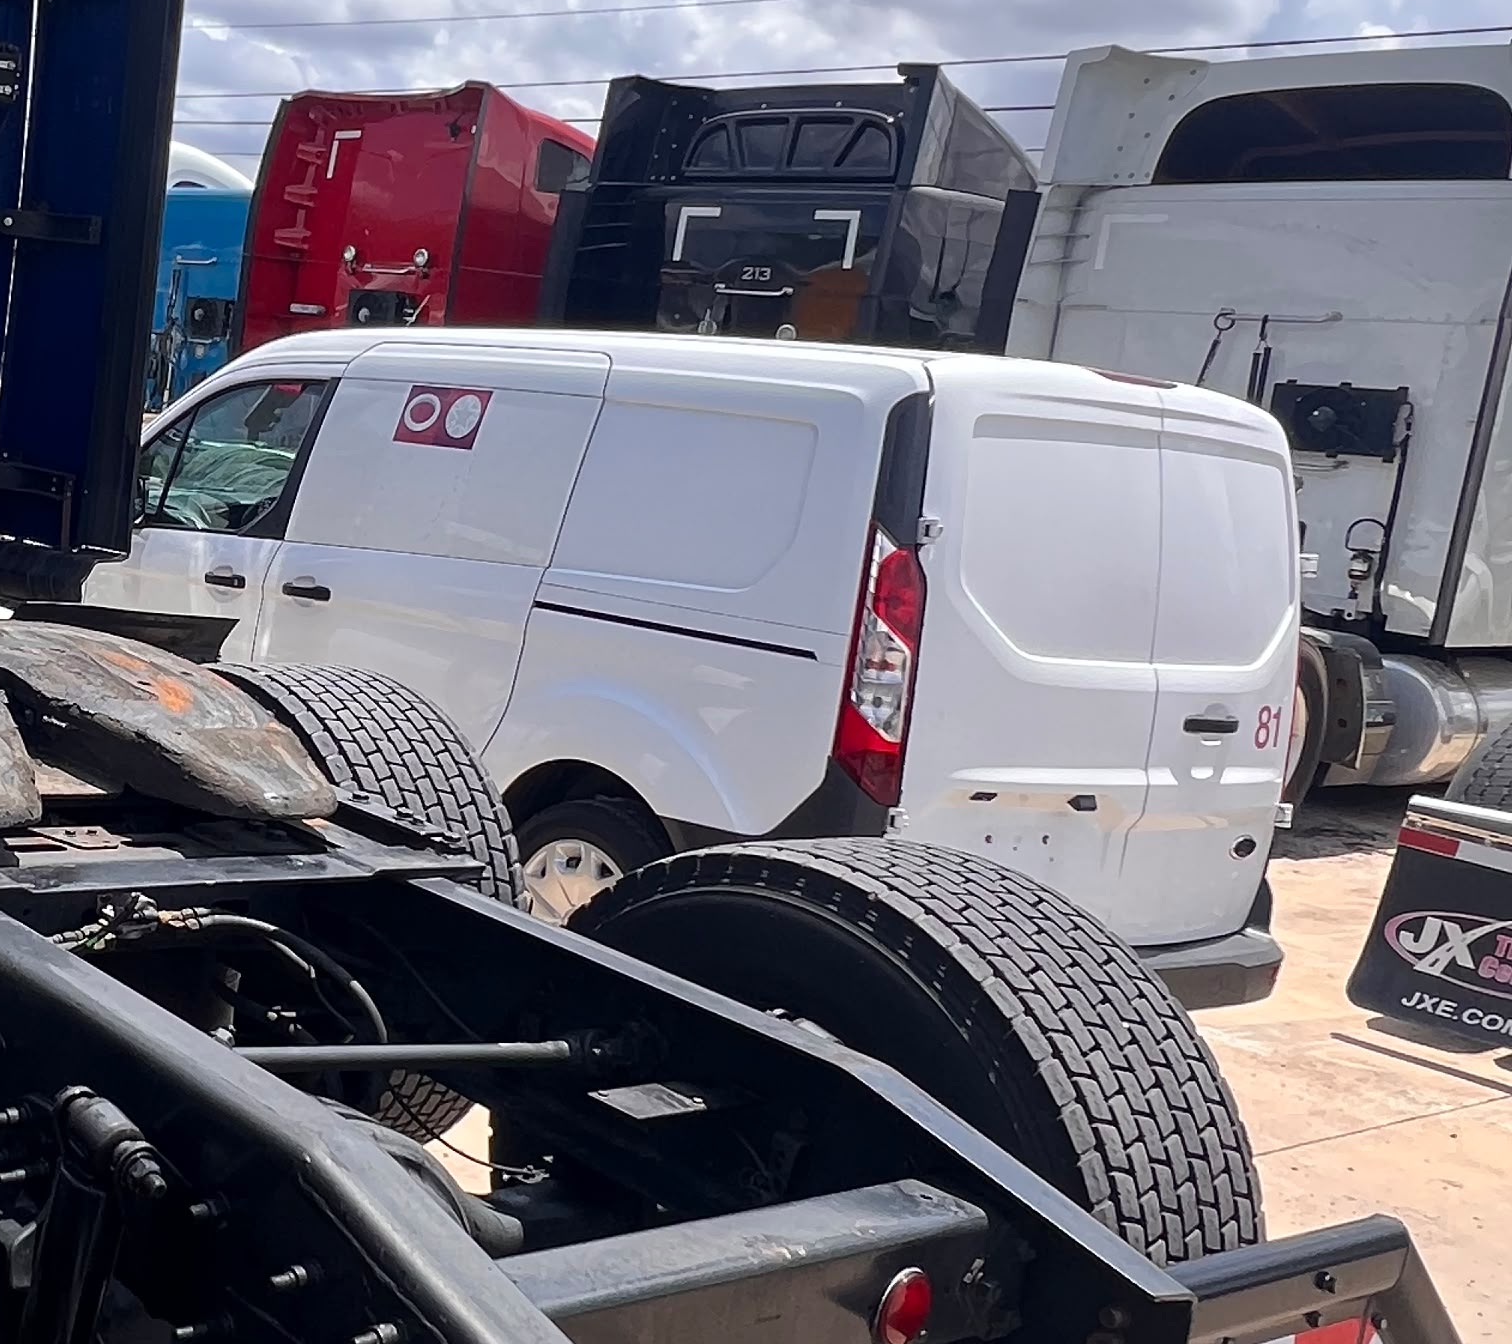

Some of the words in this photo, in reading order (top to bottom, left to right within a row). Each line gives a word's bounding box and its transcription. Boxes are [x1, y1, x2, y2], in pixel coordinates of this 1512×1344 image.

[741, 266, 772, 281] 213
[1254, 704, 1283, 749] 81
[1398, 916, 1476, 975] JX
